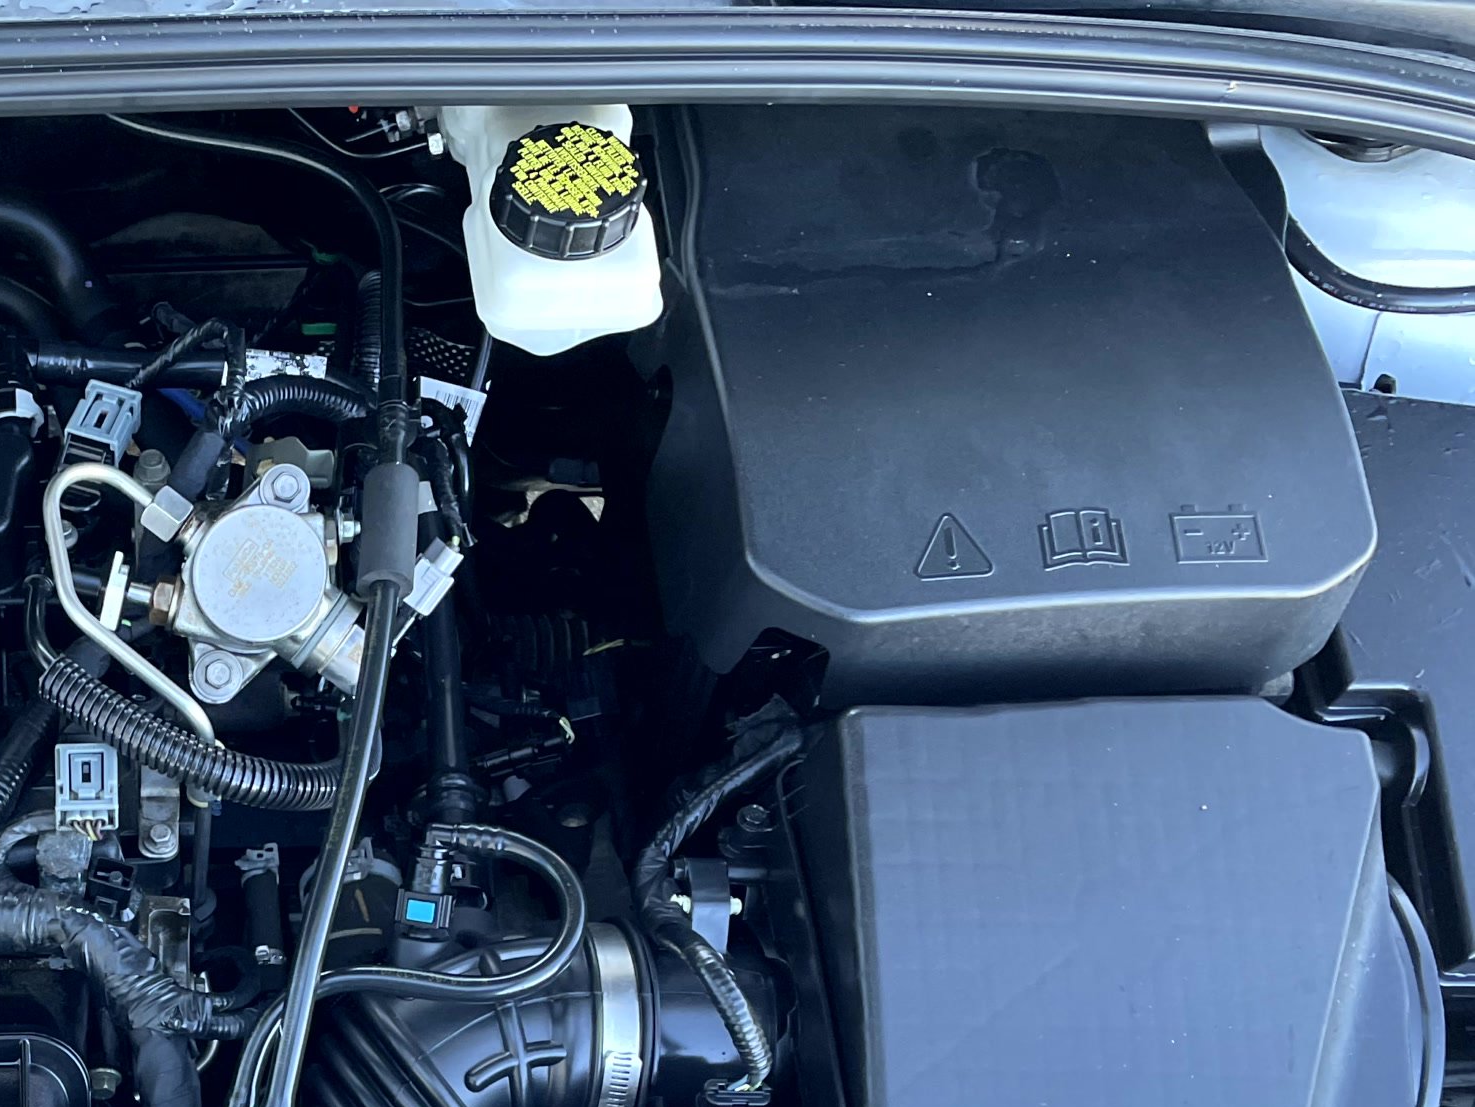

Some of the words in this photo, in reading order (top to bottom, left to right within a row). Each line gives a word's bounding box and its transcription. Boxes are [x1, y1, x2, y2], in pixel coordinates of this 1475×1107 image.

[560, 127, 579, 142] ONLY
[609, 177, 630, 196] FROM
[562, 140, 586, 162] SEALED
[585, 127, 608, 146] CLEAN
[603, 145, 626, 166] FILLER
[623, 164, 638, 177] CAP
[621, 175, 637, 190] USE
[1206, 540, 1235, 555] 12V
